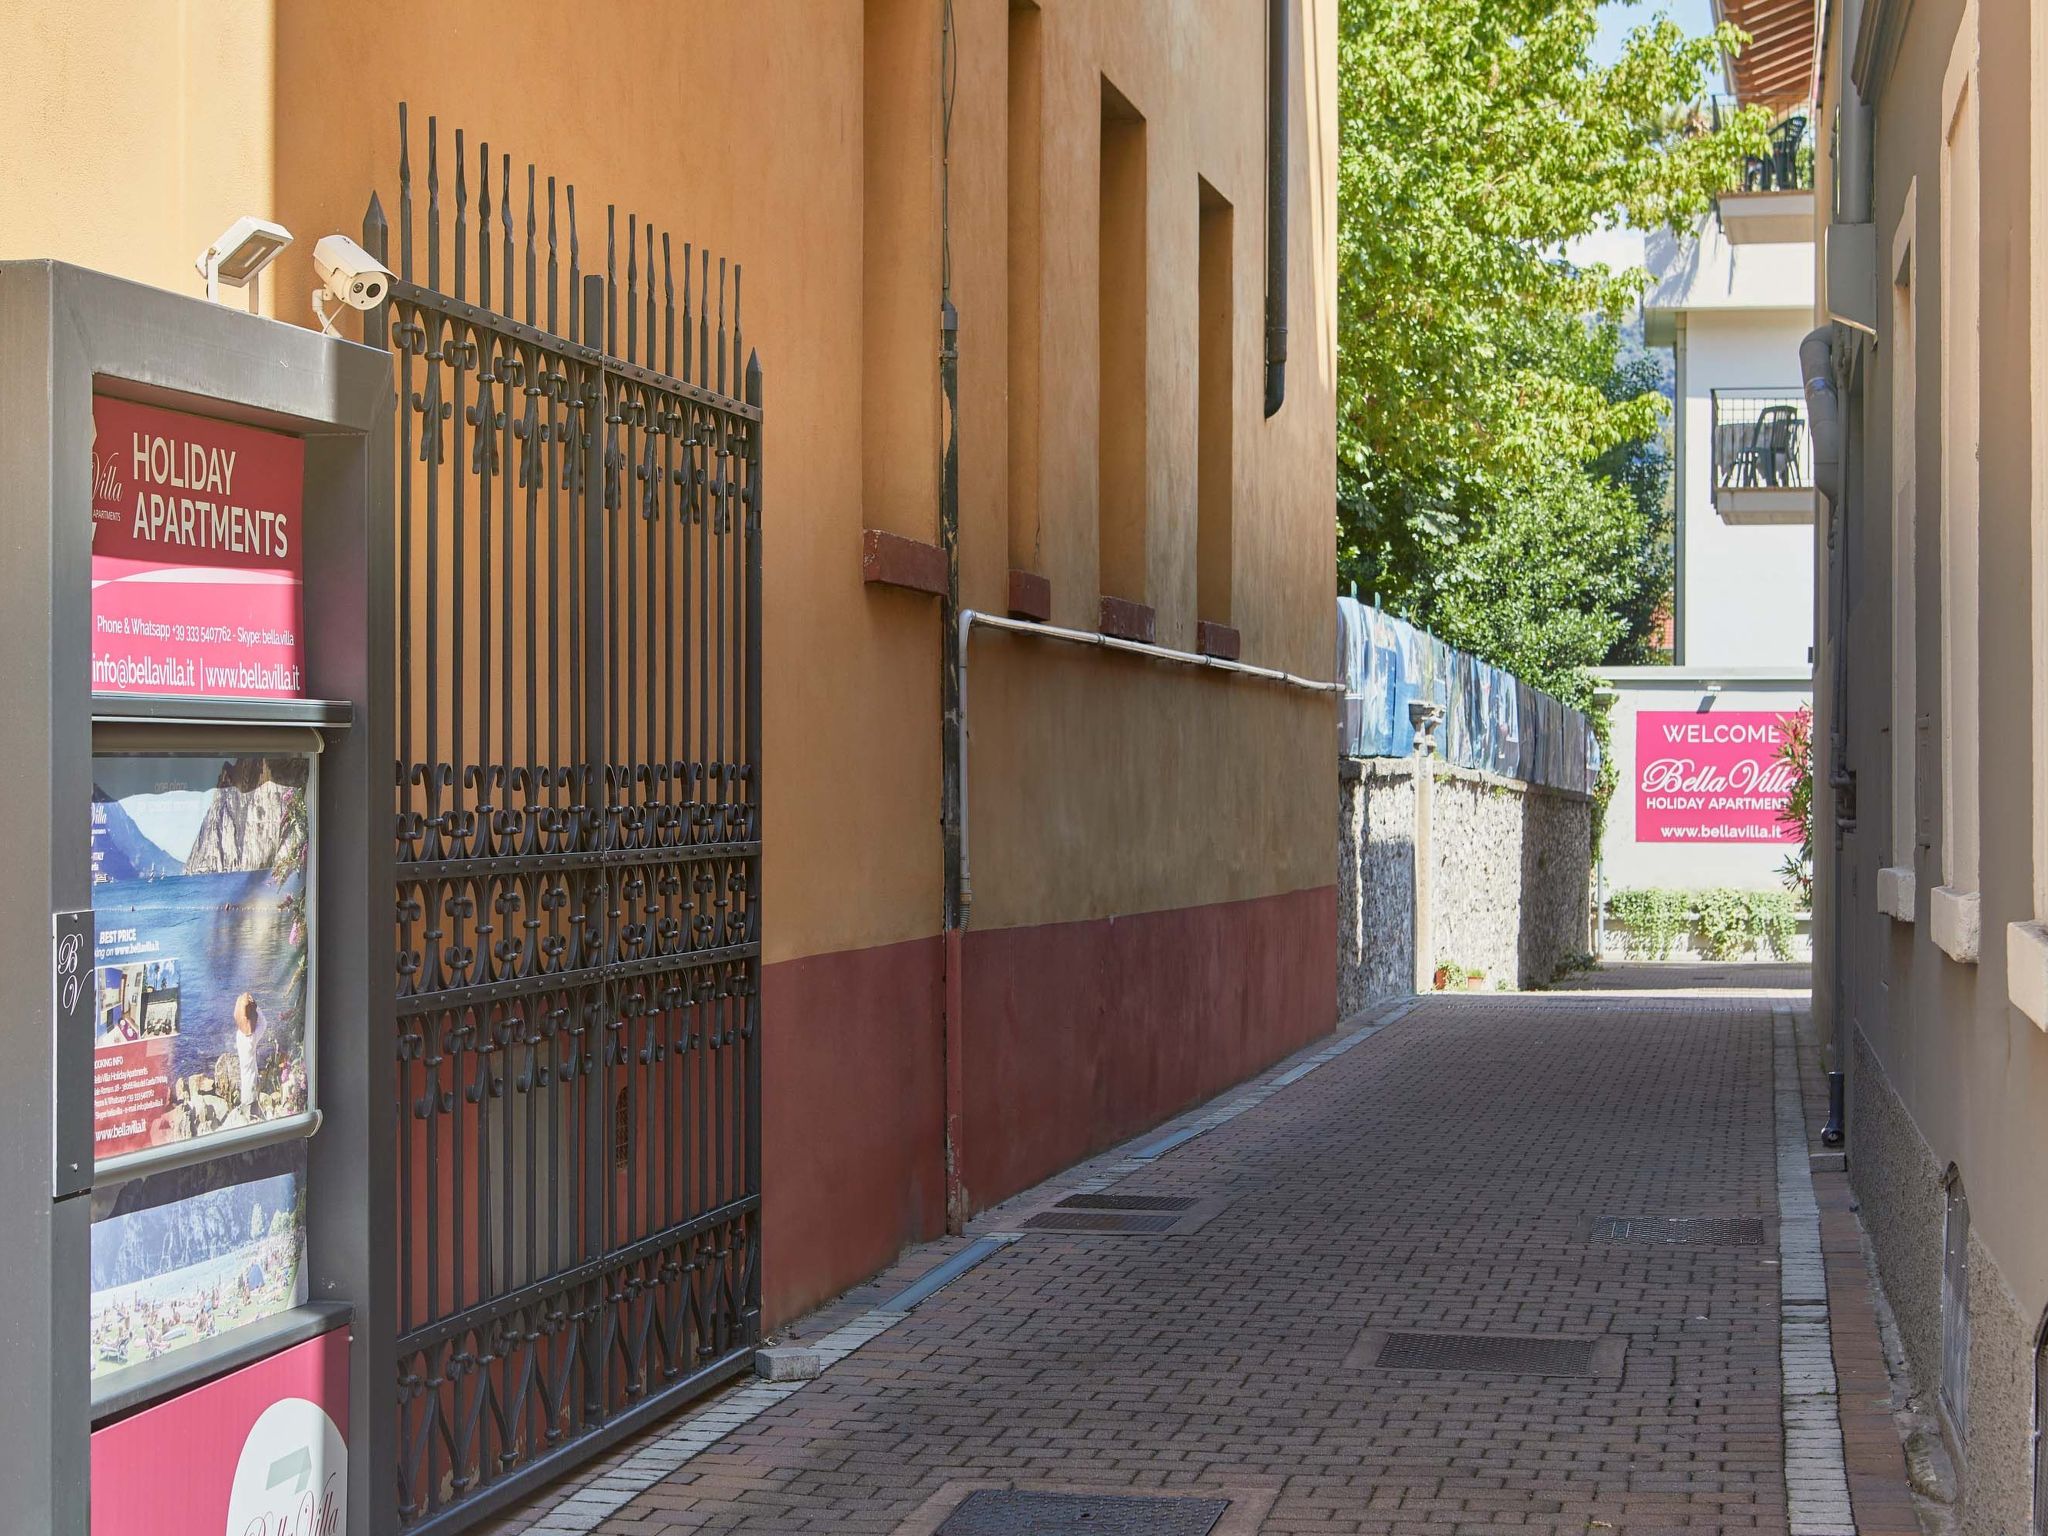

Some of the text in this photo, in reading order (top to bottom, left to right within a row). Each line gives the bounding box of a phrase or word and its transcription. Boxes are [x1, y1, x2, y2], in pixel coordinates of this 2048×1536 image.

[133, 431, 236, 496] HOLIDAY
[132, 491, 288, 558] APARTMENTS
[97, 615, 122, 634] Phone
[124, 617, 130, 634] &
[131, 618, 170, 640] Whatsapp
[172, 625, 185, 641] +39
[186, 625, 200, 642] 333
[200, 626, 232, 643] 5407762
[237, 627, 262, 647] Skype:
[92, 653, 195, 689] info@bellavilla.it
[205, 661, 301, 691] www.bellavilla.it
[1662, 724, 1781, 743] WELCOME
[1641, 758, 1728, 793] Bella
[1646, 797, 1705, 810] HOLIDAY
[1660, 824, 1782, 839] www.bellavilla.it
[99, 928, 137, 945] BEST PRICE
[106, 947, 114, 957] on
[114, 940, 160, 956] www.bellavilla.it
[95, 1118, 147, 1141] www.bellavilla.it
